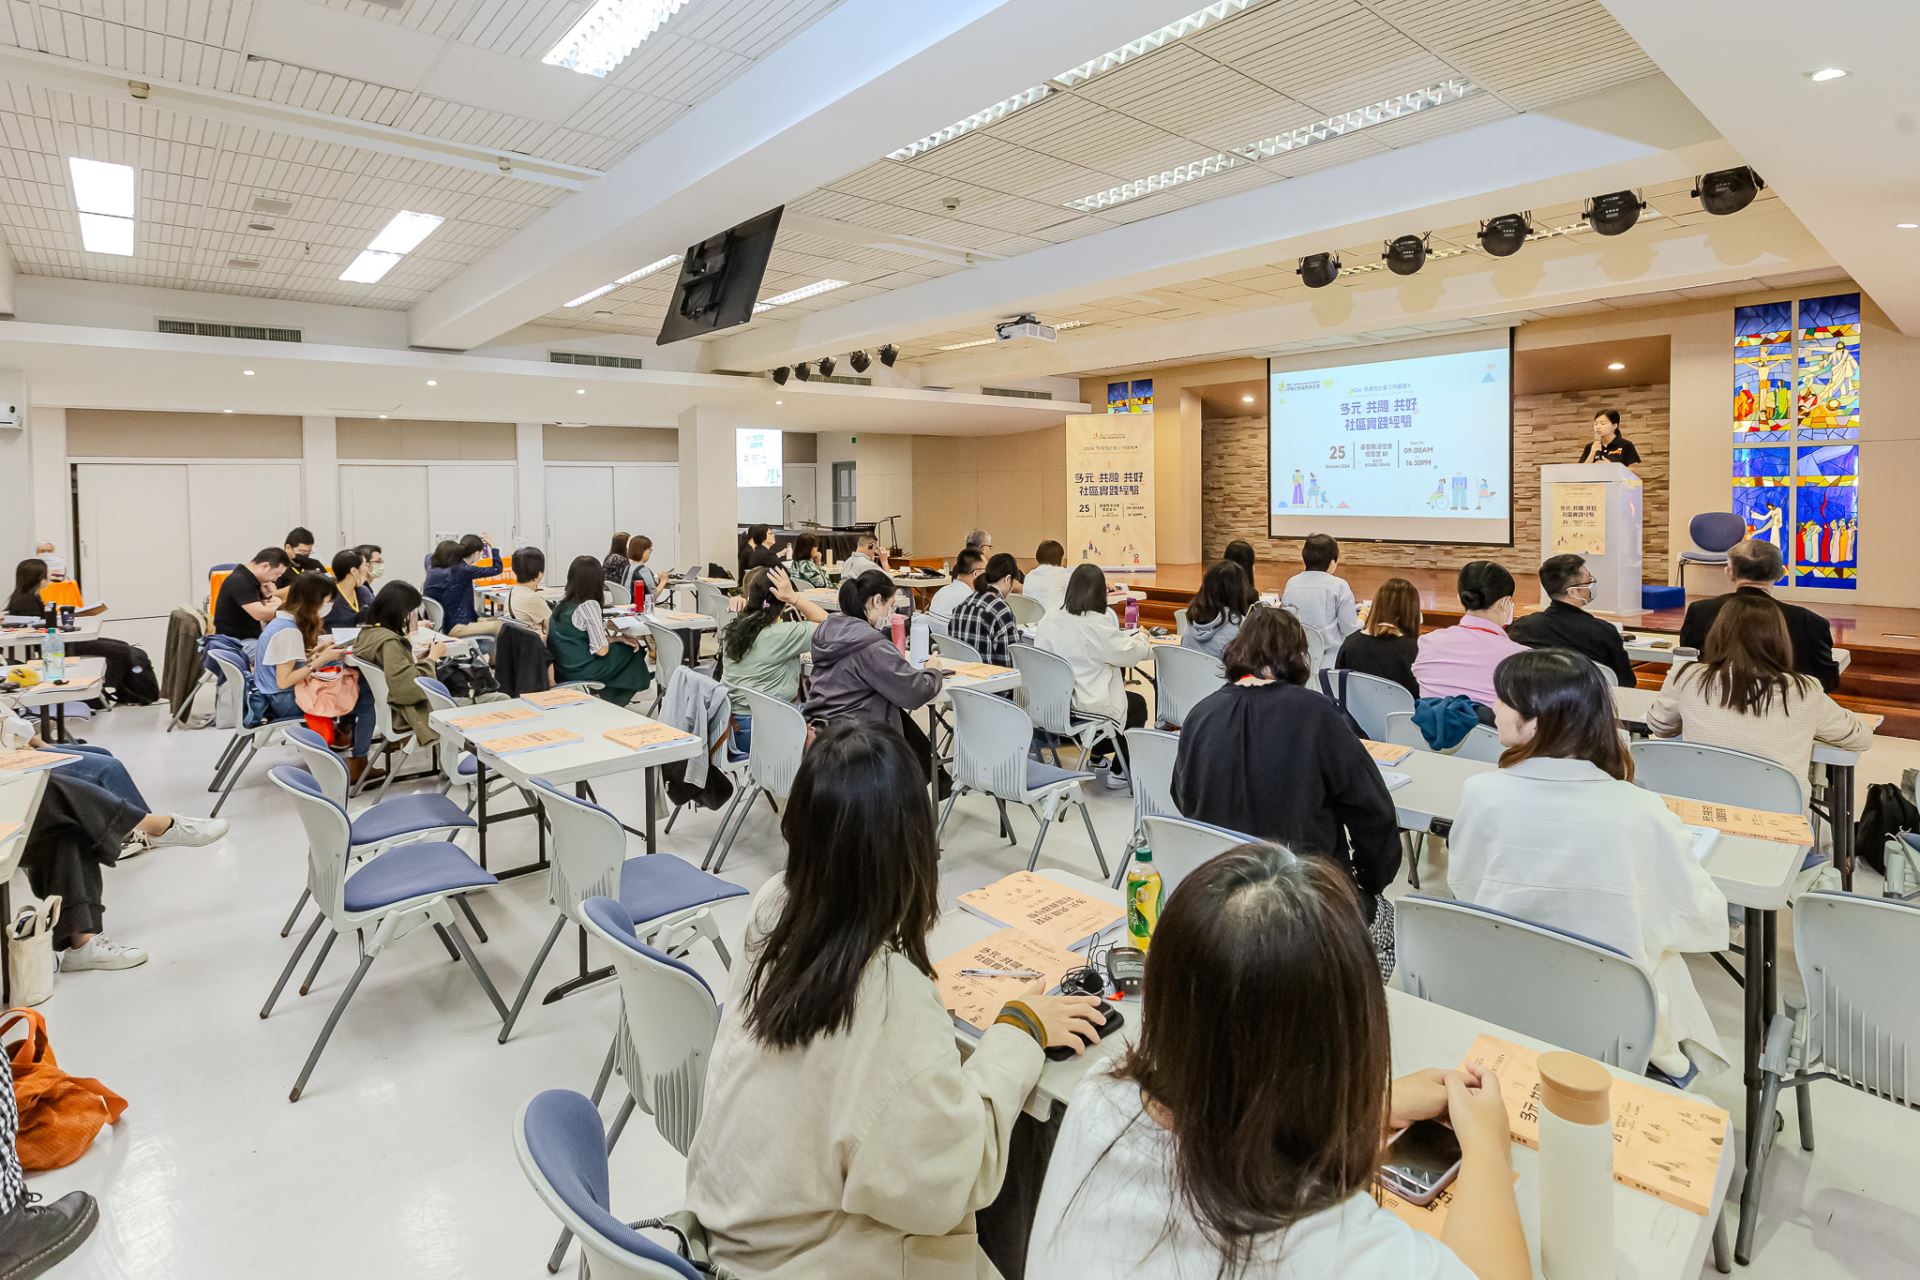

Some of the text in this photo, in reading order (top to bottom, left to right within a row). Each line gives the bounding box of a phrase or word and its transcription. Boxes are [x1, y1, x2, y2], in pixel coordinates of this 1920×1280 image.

[1340, 397, 1417, 415] 多元 共融 共好
[1344, 415, 1412, 431] 社區實踐經驗
[1329, 445, 1346, 459] 25
[1074, 471, 1143, 483] 多元 共融 共好
[1079, 485, 1139, 496] 社區實踐經驗
[1079, 504, 1090, 512] 25
